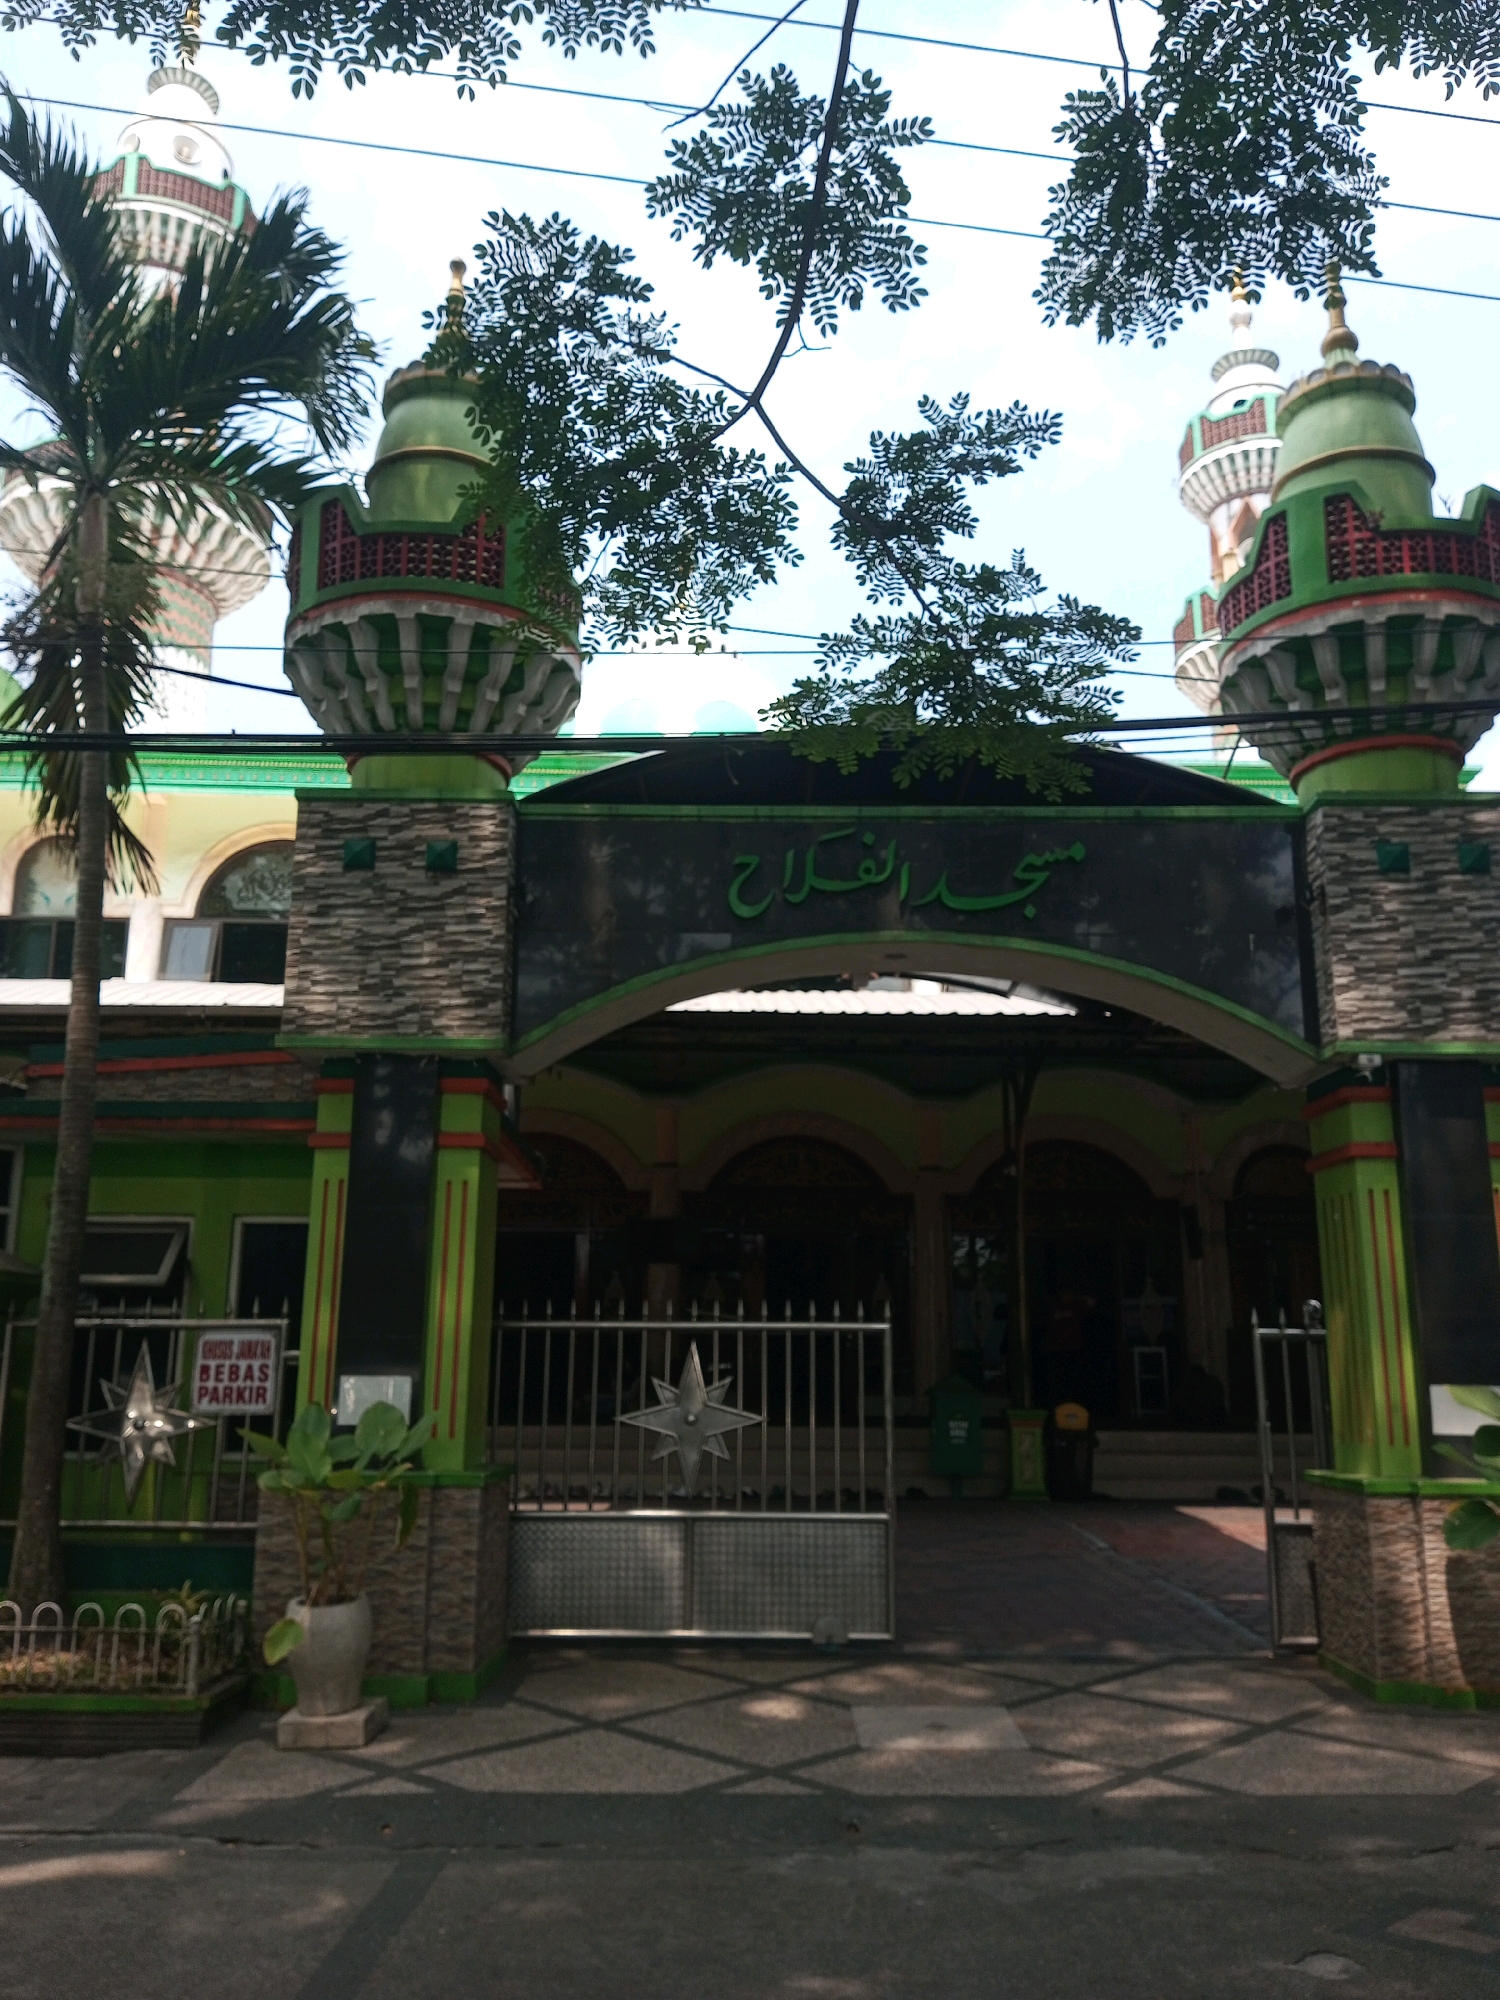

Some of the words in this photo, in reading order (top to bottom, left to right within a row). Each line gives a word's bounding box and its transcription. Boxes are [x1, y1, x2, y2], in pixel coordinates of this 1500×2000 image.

[909, 840, 1086, 919] مسجد
[199, 1363, 269, 1383] BEBAS
[197, 1385, 268, 1405] PARKIR
